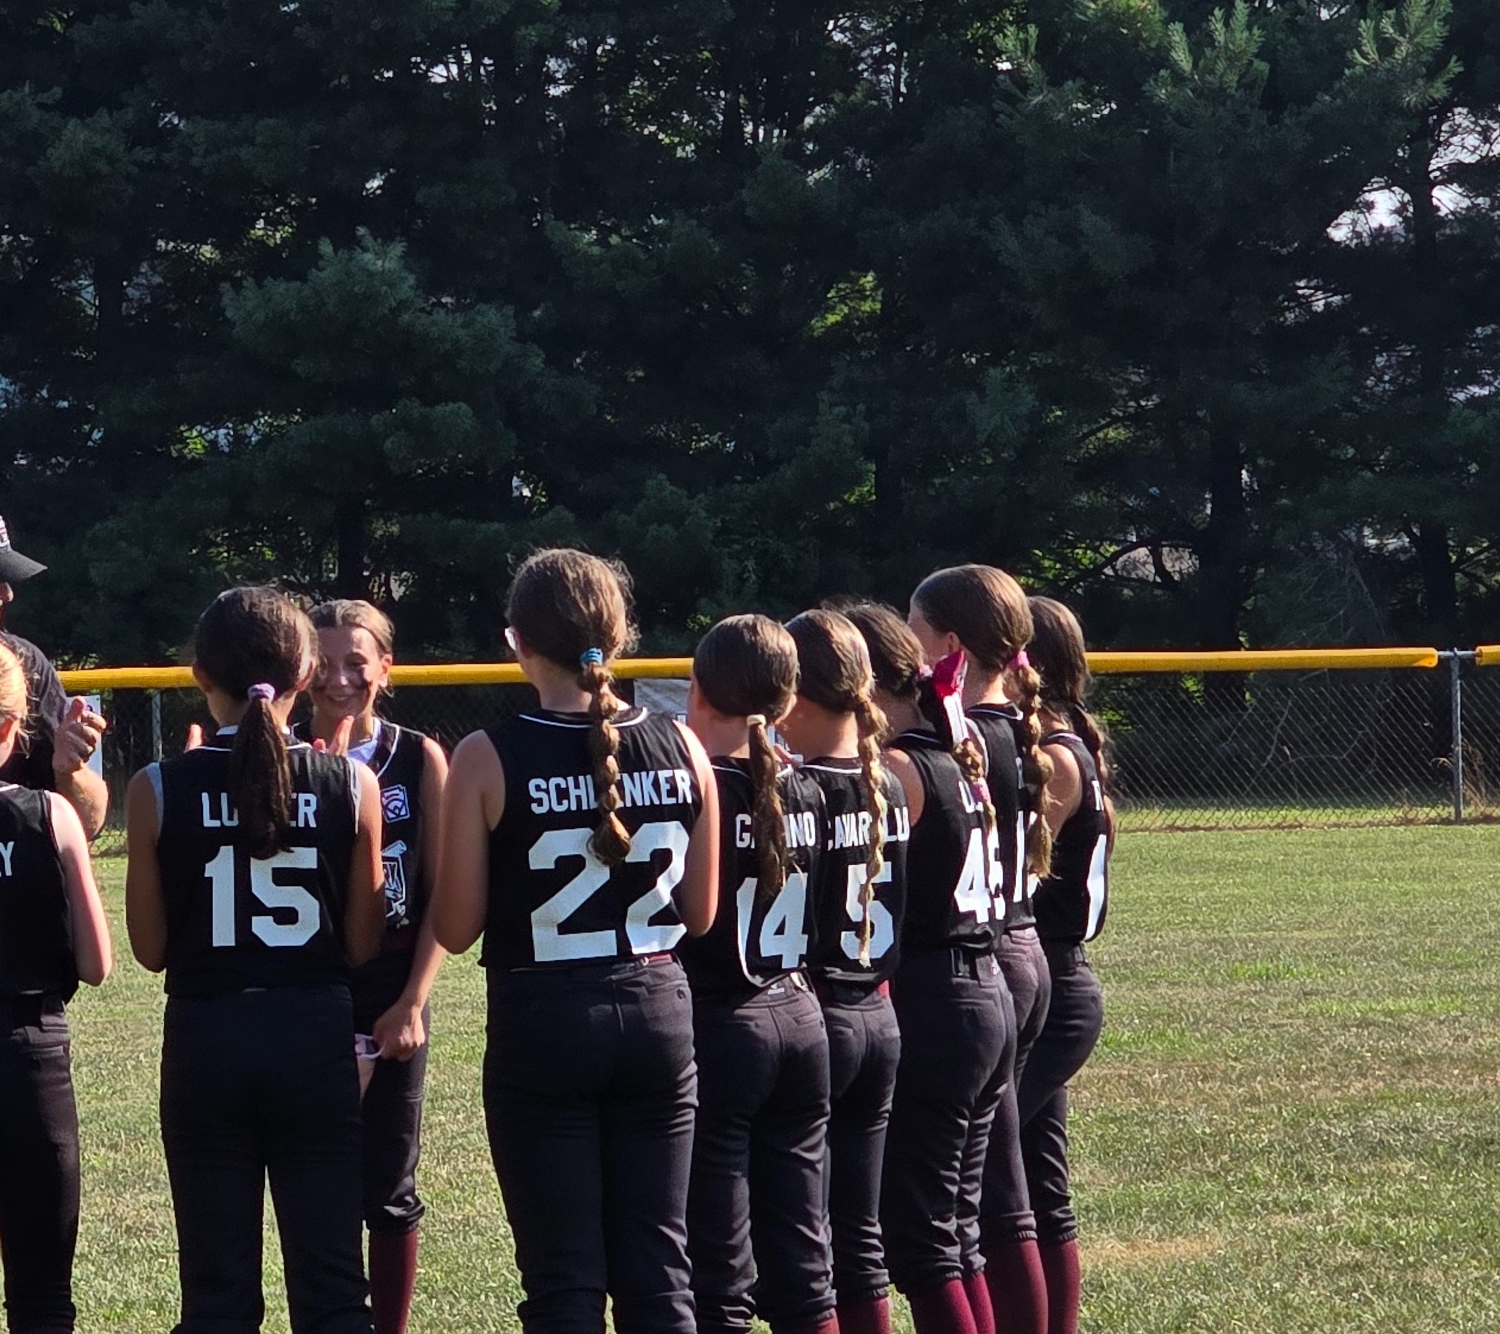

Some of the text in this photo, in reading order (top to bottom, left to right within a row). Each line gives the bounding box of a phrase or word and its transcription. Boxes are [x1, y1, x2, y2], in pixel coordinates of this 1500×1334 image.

[204, 845, 320, 947] 15
[528, 820, 690, 962] 22
[736, 872, 808, 969] 14
[840, 861, 894, 960] 5
